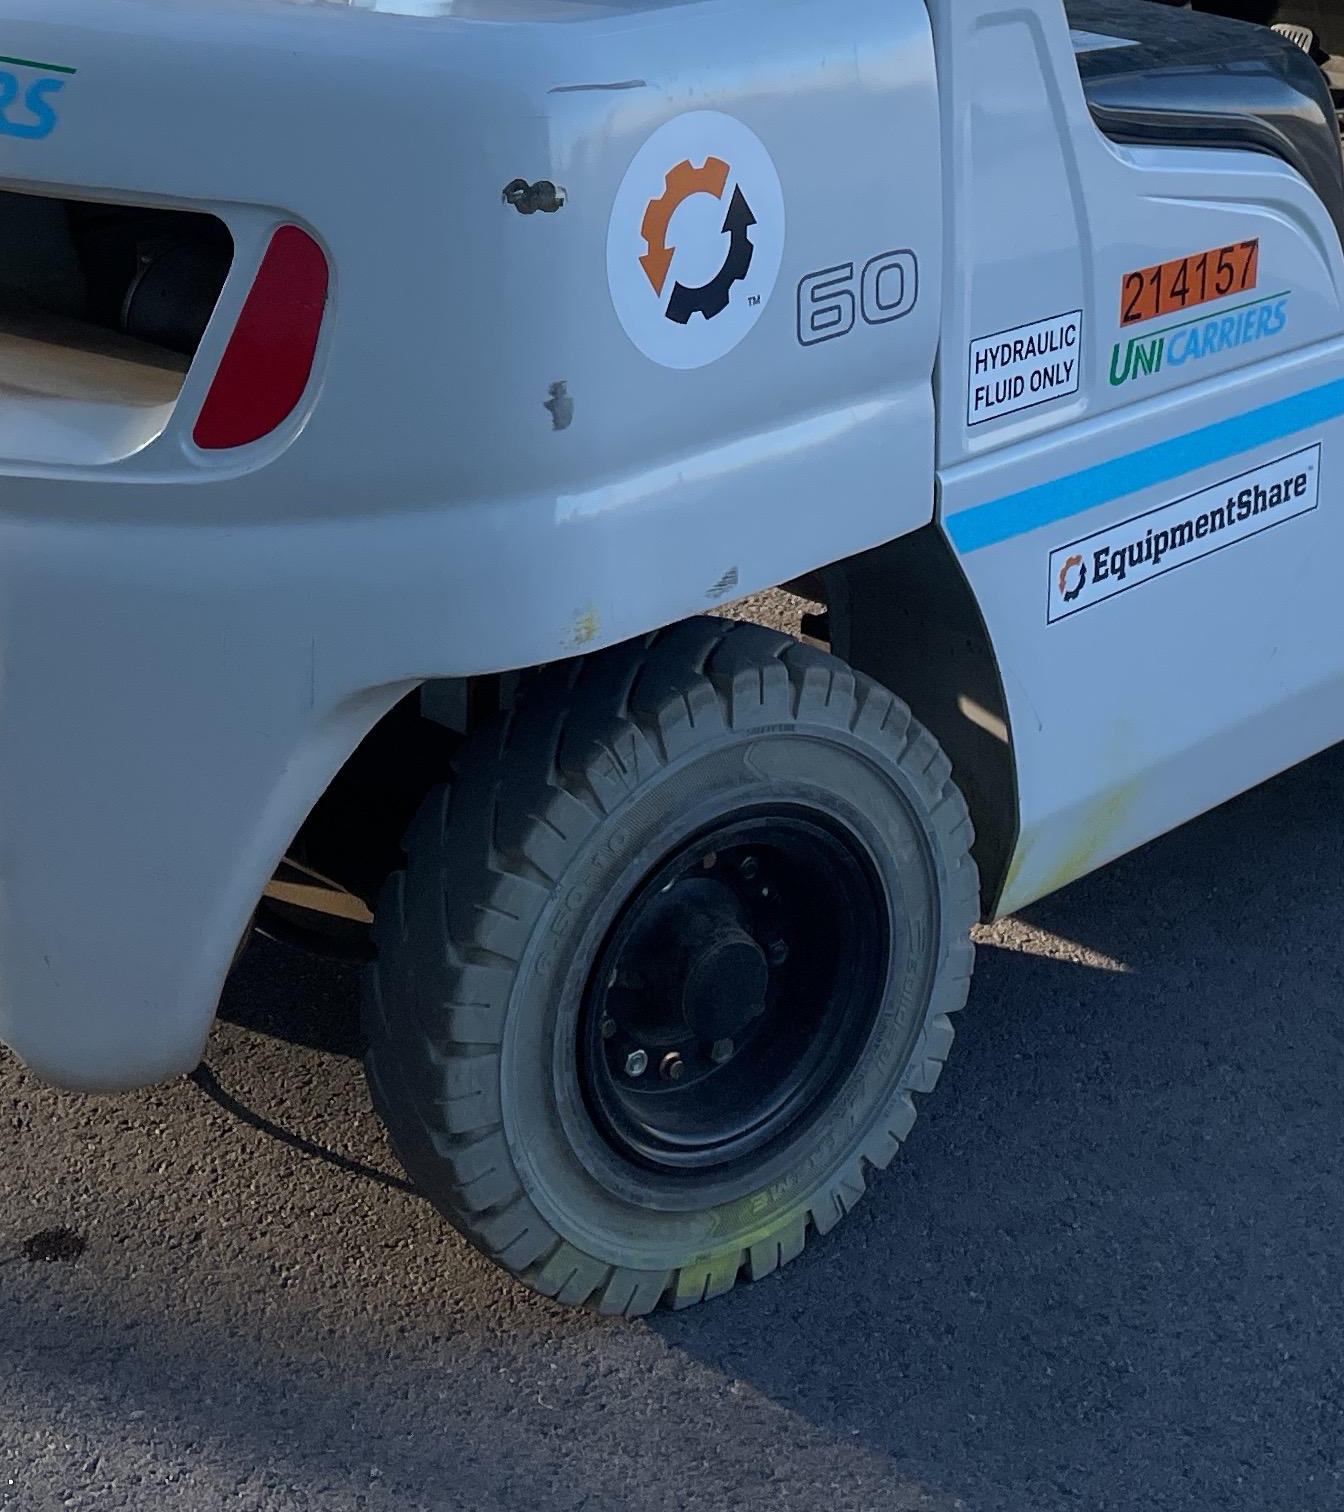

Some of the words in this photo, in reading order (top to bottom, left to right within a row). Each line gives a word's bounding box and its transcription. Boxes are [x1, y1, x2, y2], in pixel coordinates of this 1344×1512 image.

[796, 248, 919, 347] 60
[1122, 238, 1259, 324] 214157
[975, 324, 1077, 375] HYDRAULIC
[975, 374, 1025, 411] FLUID
[1030, 359, 1075, 393] ONLY
[1091, 471, 1308, 581] EquipmentShare
